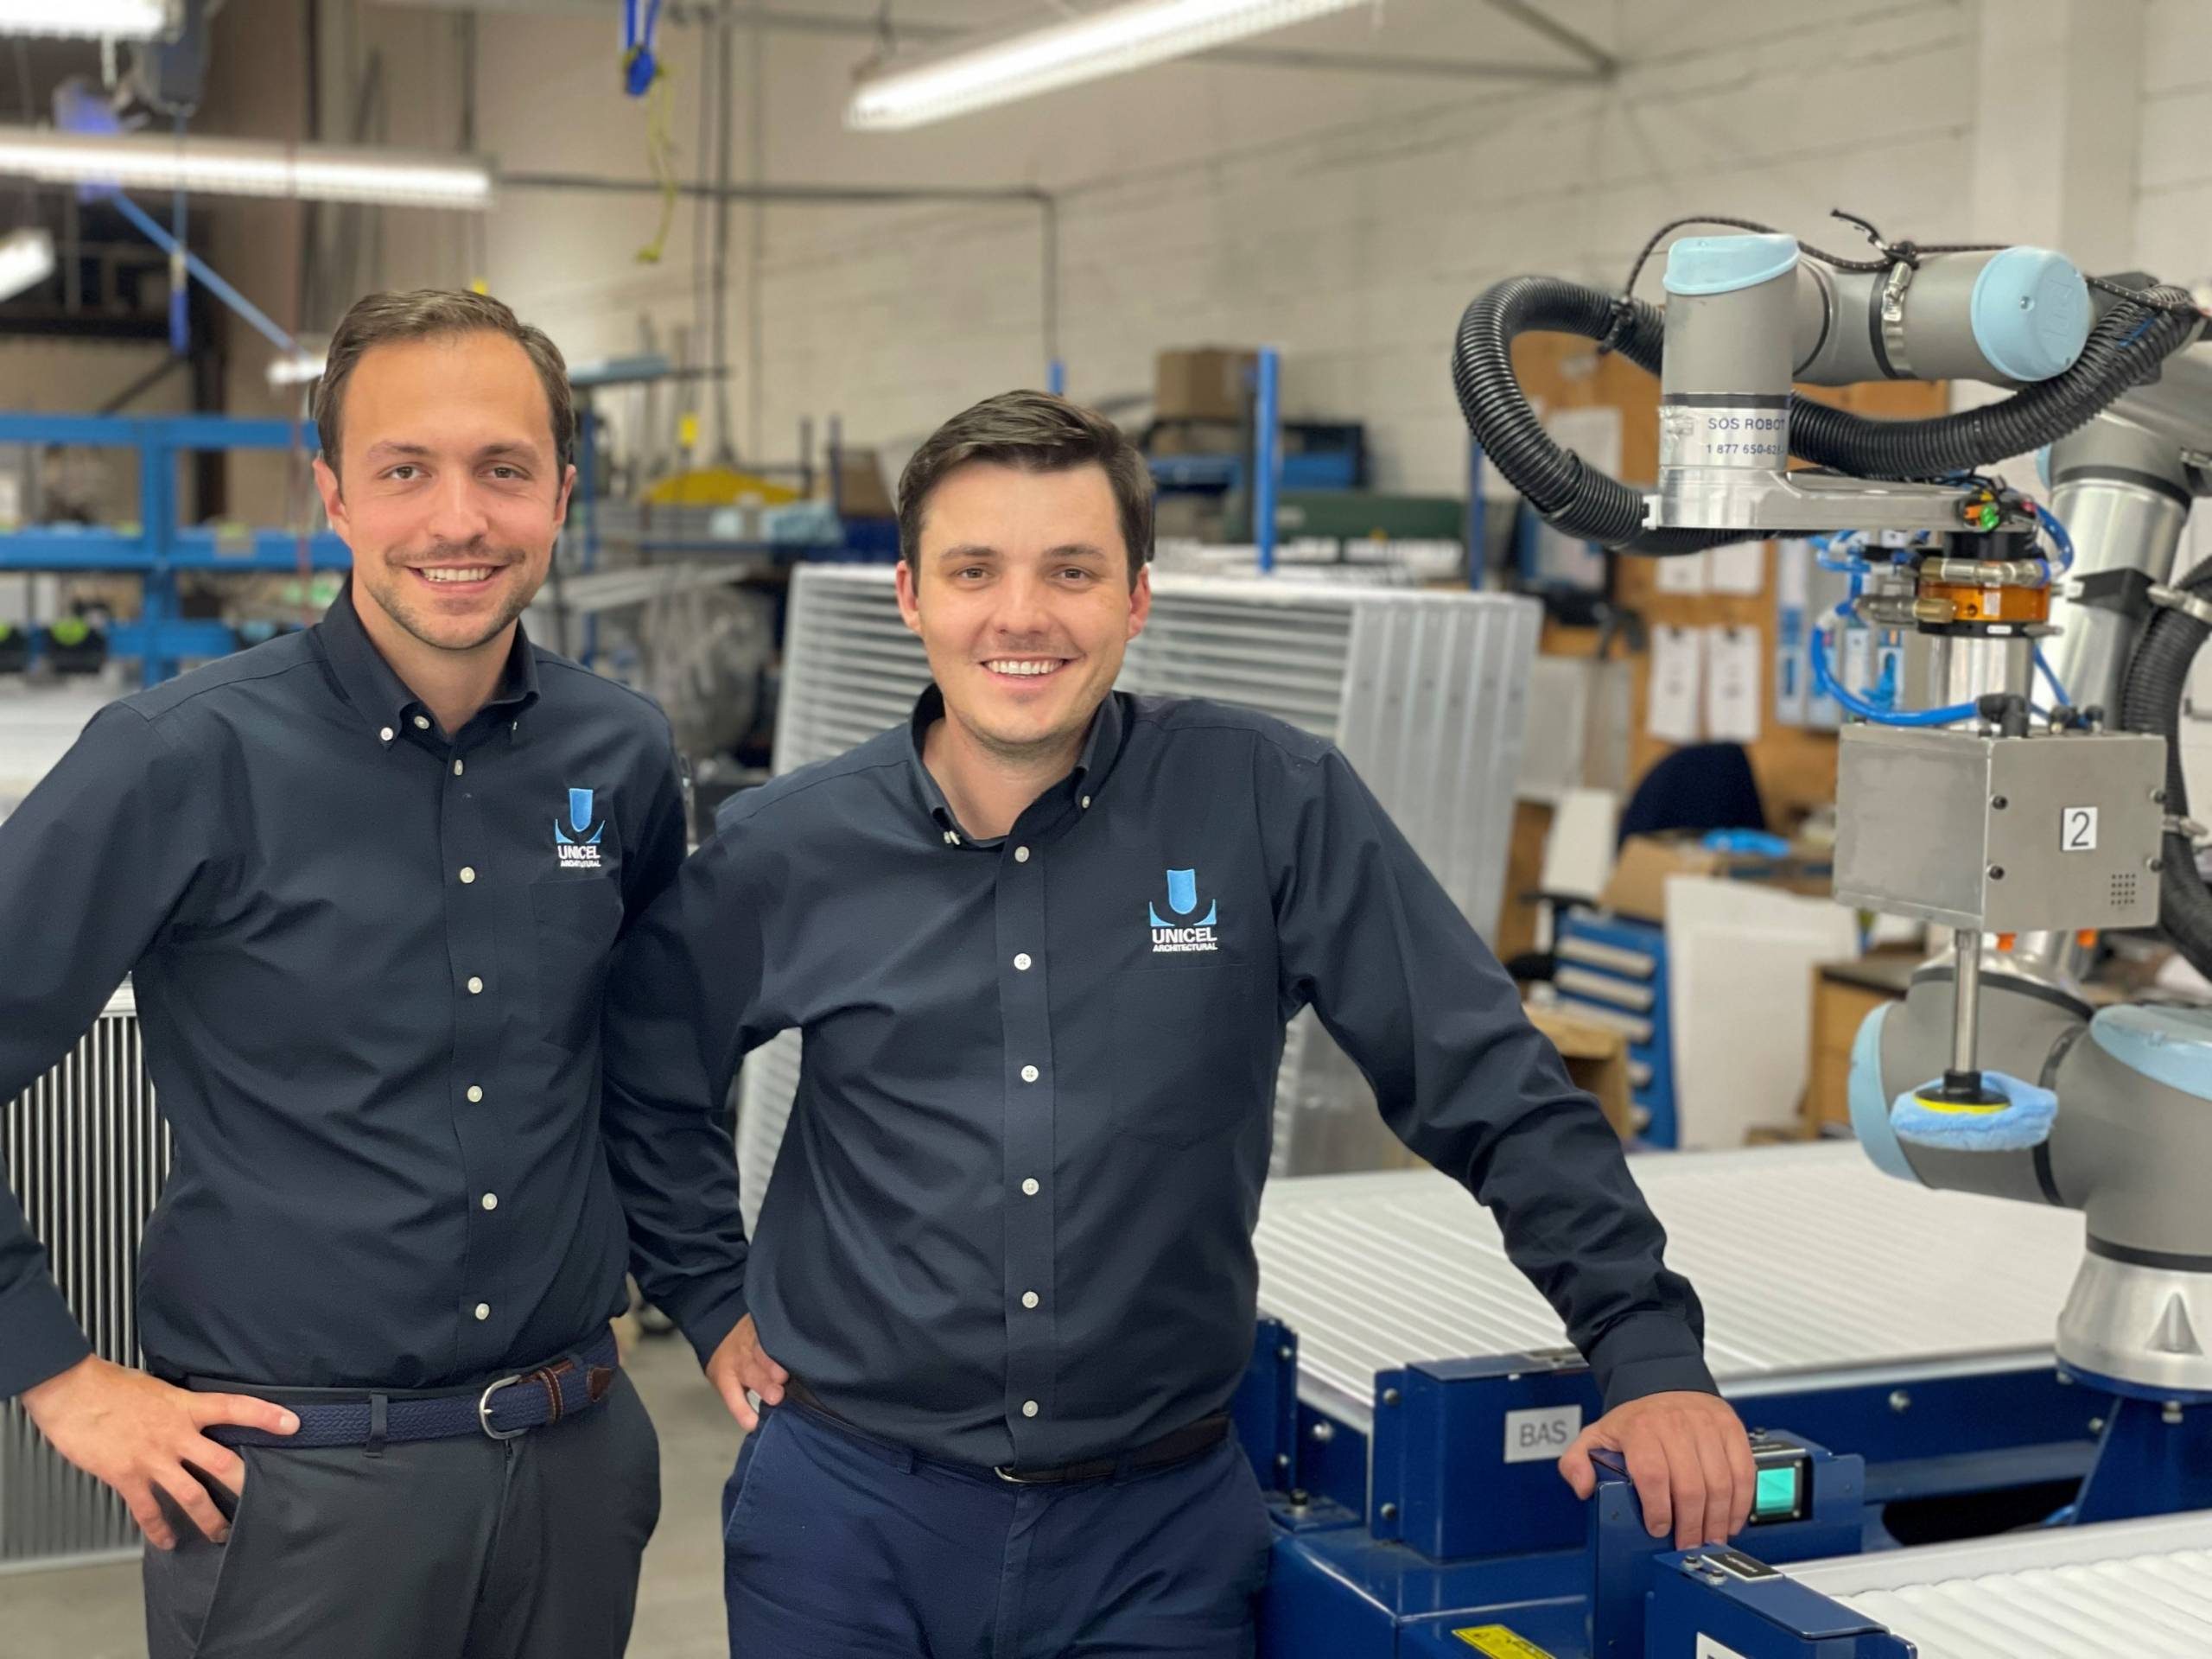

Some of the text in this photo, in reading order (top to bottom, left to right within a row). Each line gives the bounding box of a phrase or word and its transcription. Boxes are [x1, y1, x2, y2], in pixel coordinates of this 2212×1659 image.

[1708, 418, 1740, 430] SOS
[1707, 444, 1712, 454] 1
[1717, 444, 1738, 454] 877
[2071, 811, 2090, 847] 2
[557, 845, 601, 860] UNICEL
[1152, 926, 1217, 944] UNICEL
[1153, 943, 1218, 952] ARCHITECTURAL
[1520, 1420, 1567, 1448] BAS
